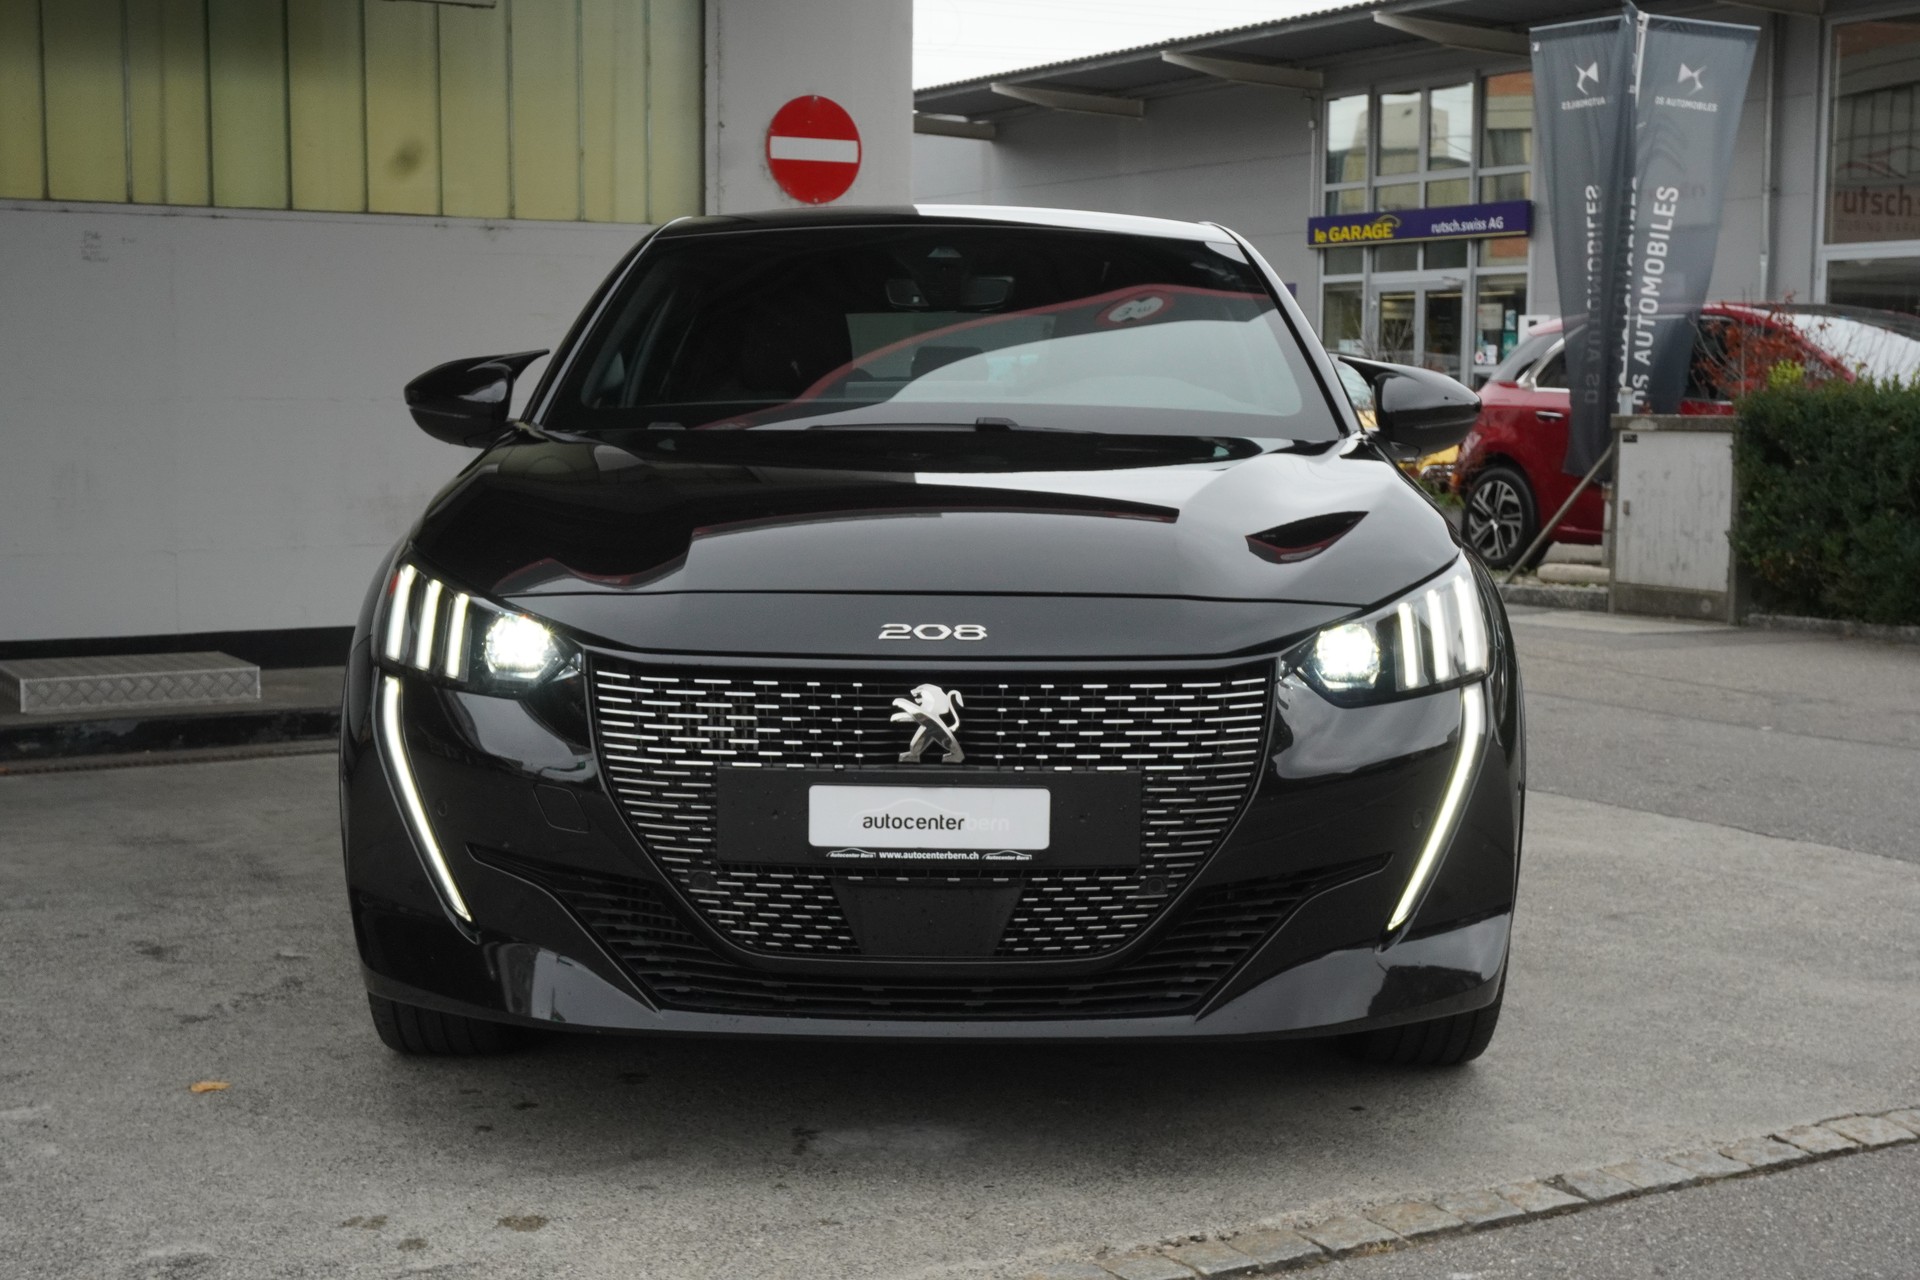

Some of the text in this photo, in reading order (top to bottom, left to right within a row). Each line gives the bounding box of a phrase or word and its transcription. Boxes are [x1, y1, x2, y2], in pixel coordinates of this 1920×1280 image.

[1314, 222, 1394, 243] le GARAGE
[1431, 215, 1504, 233] rutsch.swiss AG
[1633, 185, 1680, 367] AUTOMOBILES
[878, 623, 988, 641] 208
[879, 851, 979, 860] www.autocenterbern.ch
